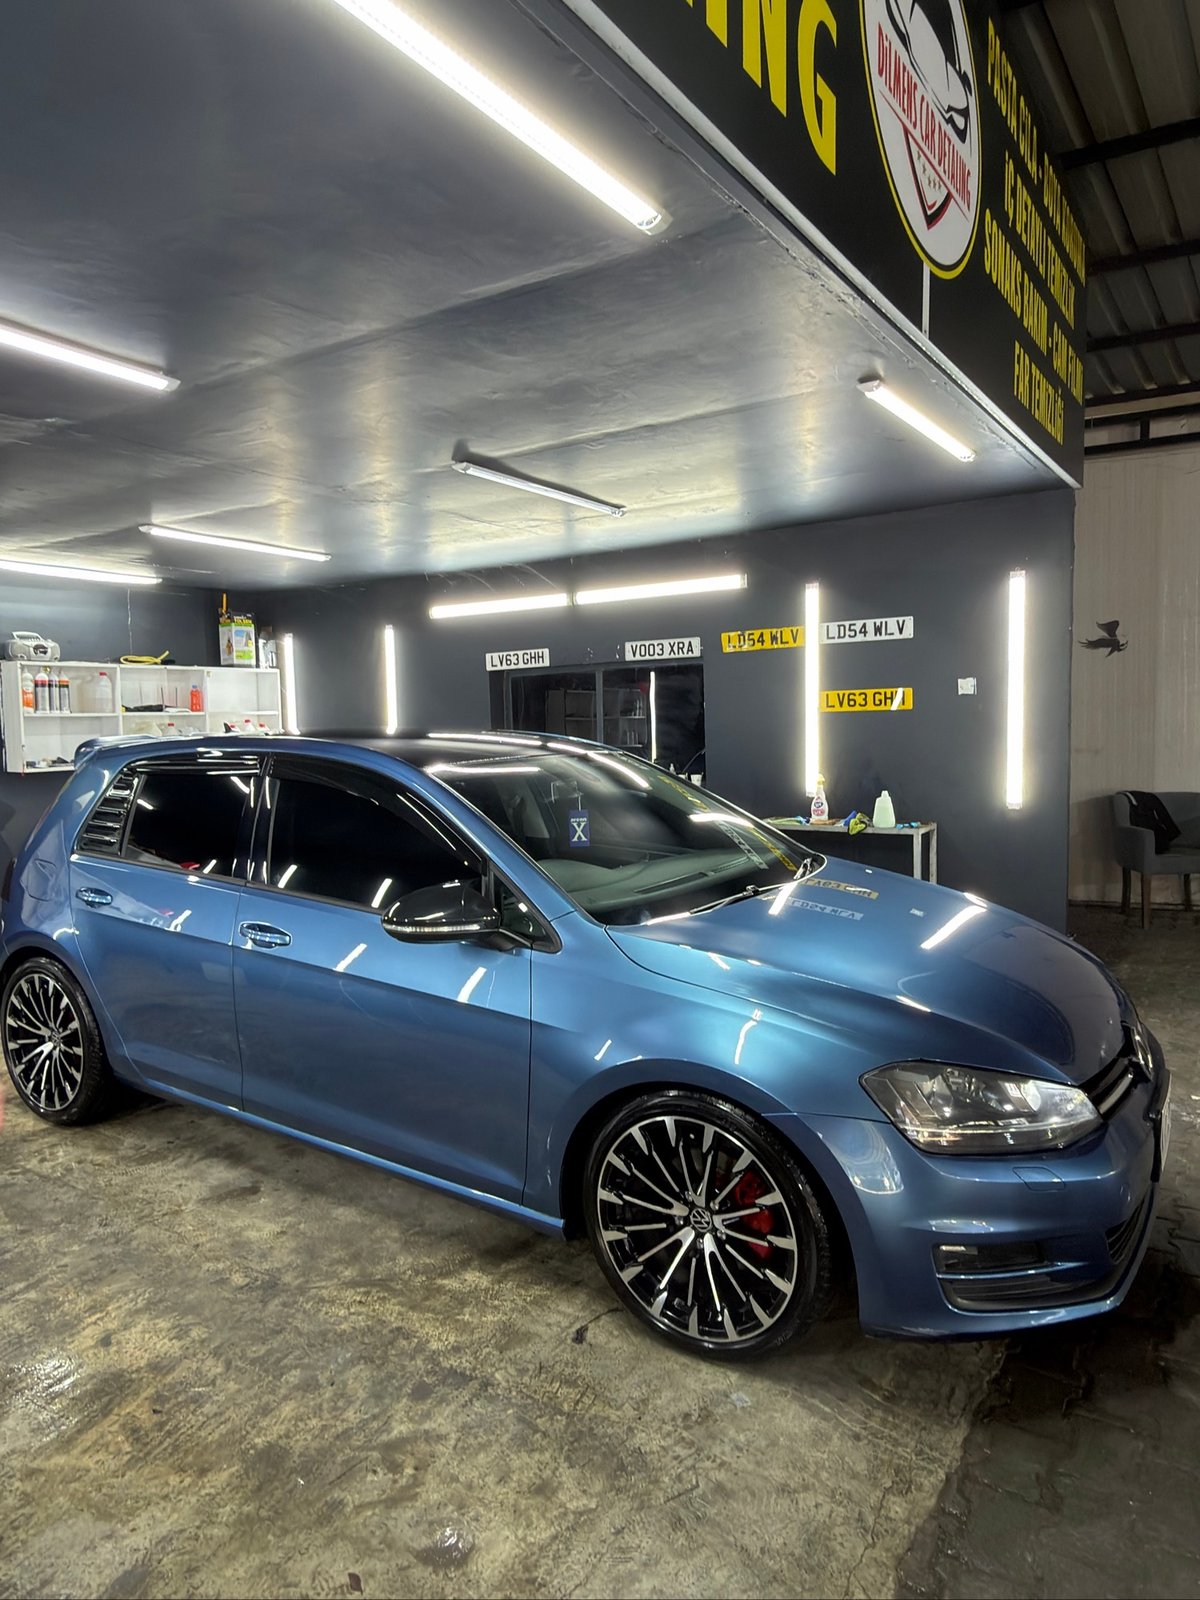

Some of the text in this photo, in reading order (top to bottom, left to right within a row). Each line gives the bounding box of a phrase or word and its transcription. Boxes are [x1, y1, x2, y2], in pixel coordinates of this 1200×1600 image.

[987, 16, 1018, 142] PASTA
[919, 94, 936, 160] CAR
[1016, 173, 1047, 279] DETAYLI
[1023, 271, 1048, 356] BAKIM
[1013, 339, 1030, 410] FAR
[727, 629, 799, 649] LD54 WLV
[826, 619, 906, 640] LD54 WLV
[668, 640, 694, 657] XRA
[490, 652, 545, 668] LV63 GHH
[826, 692, 868, 708] LV63
[571, 822, 588, 842] X
